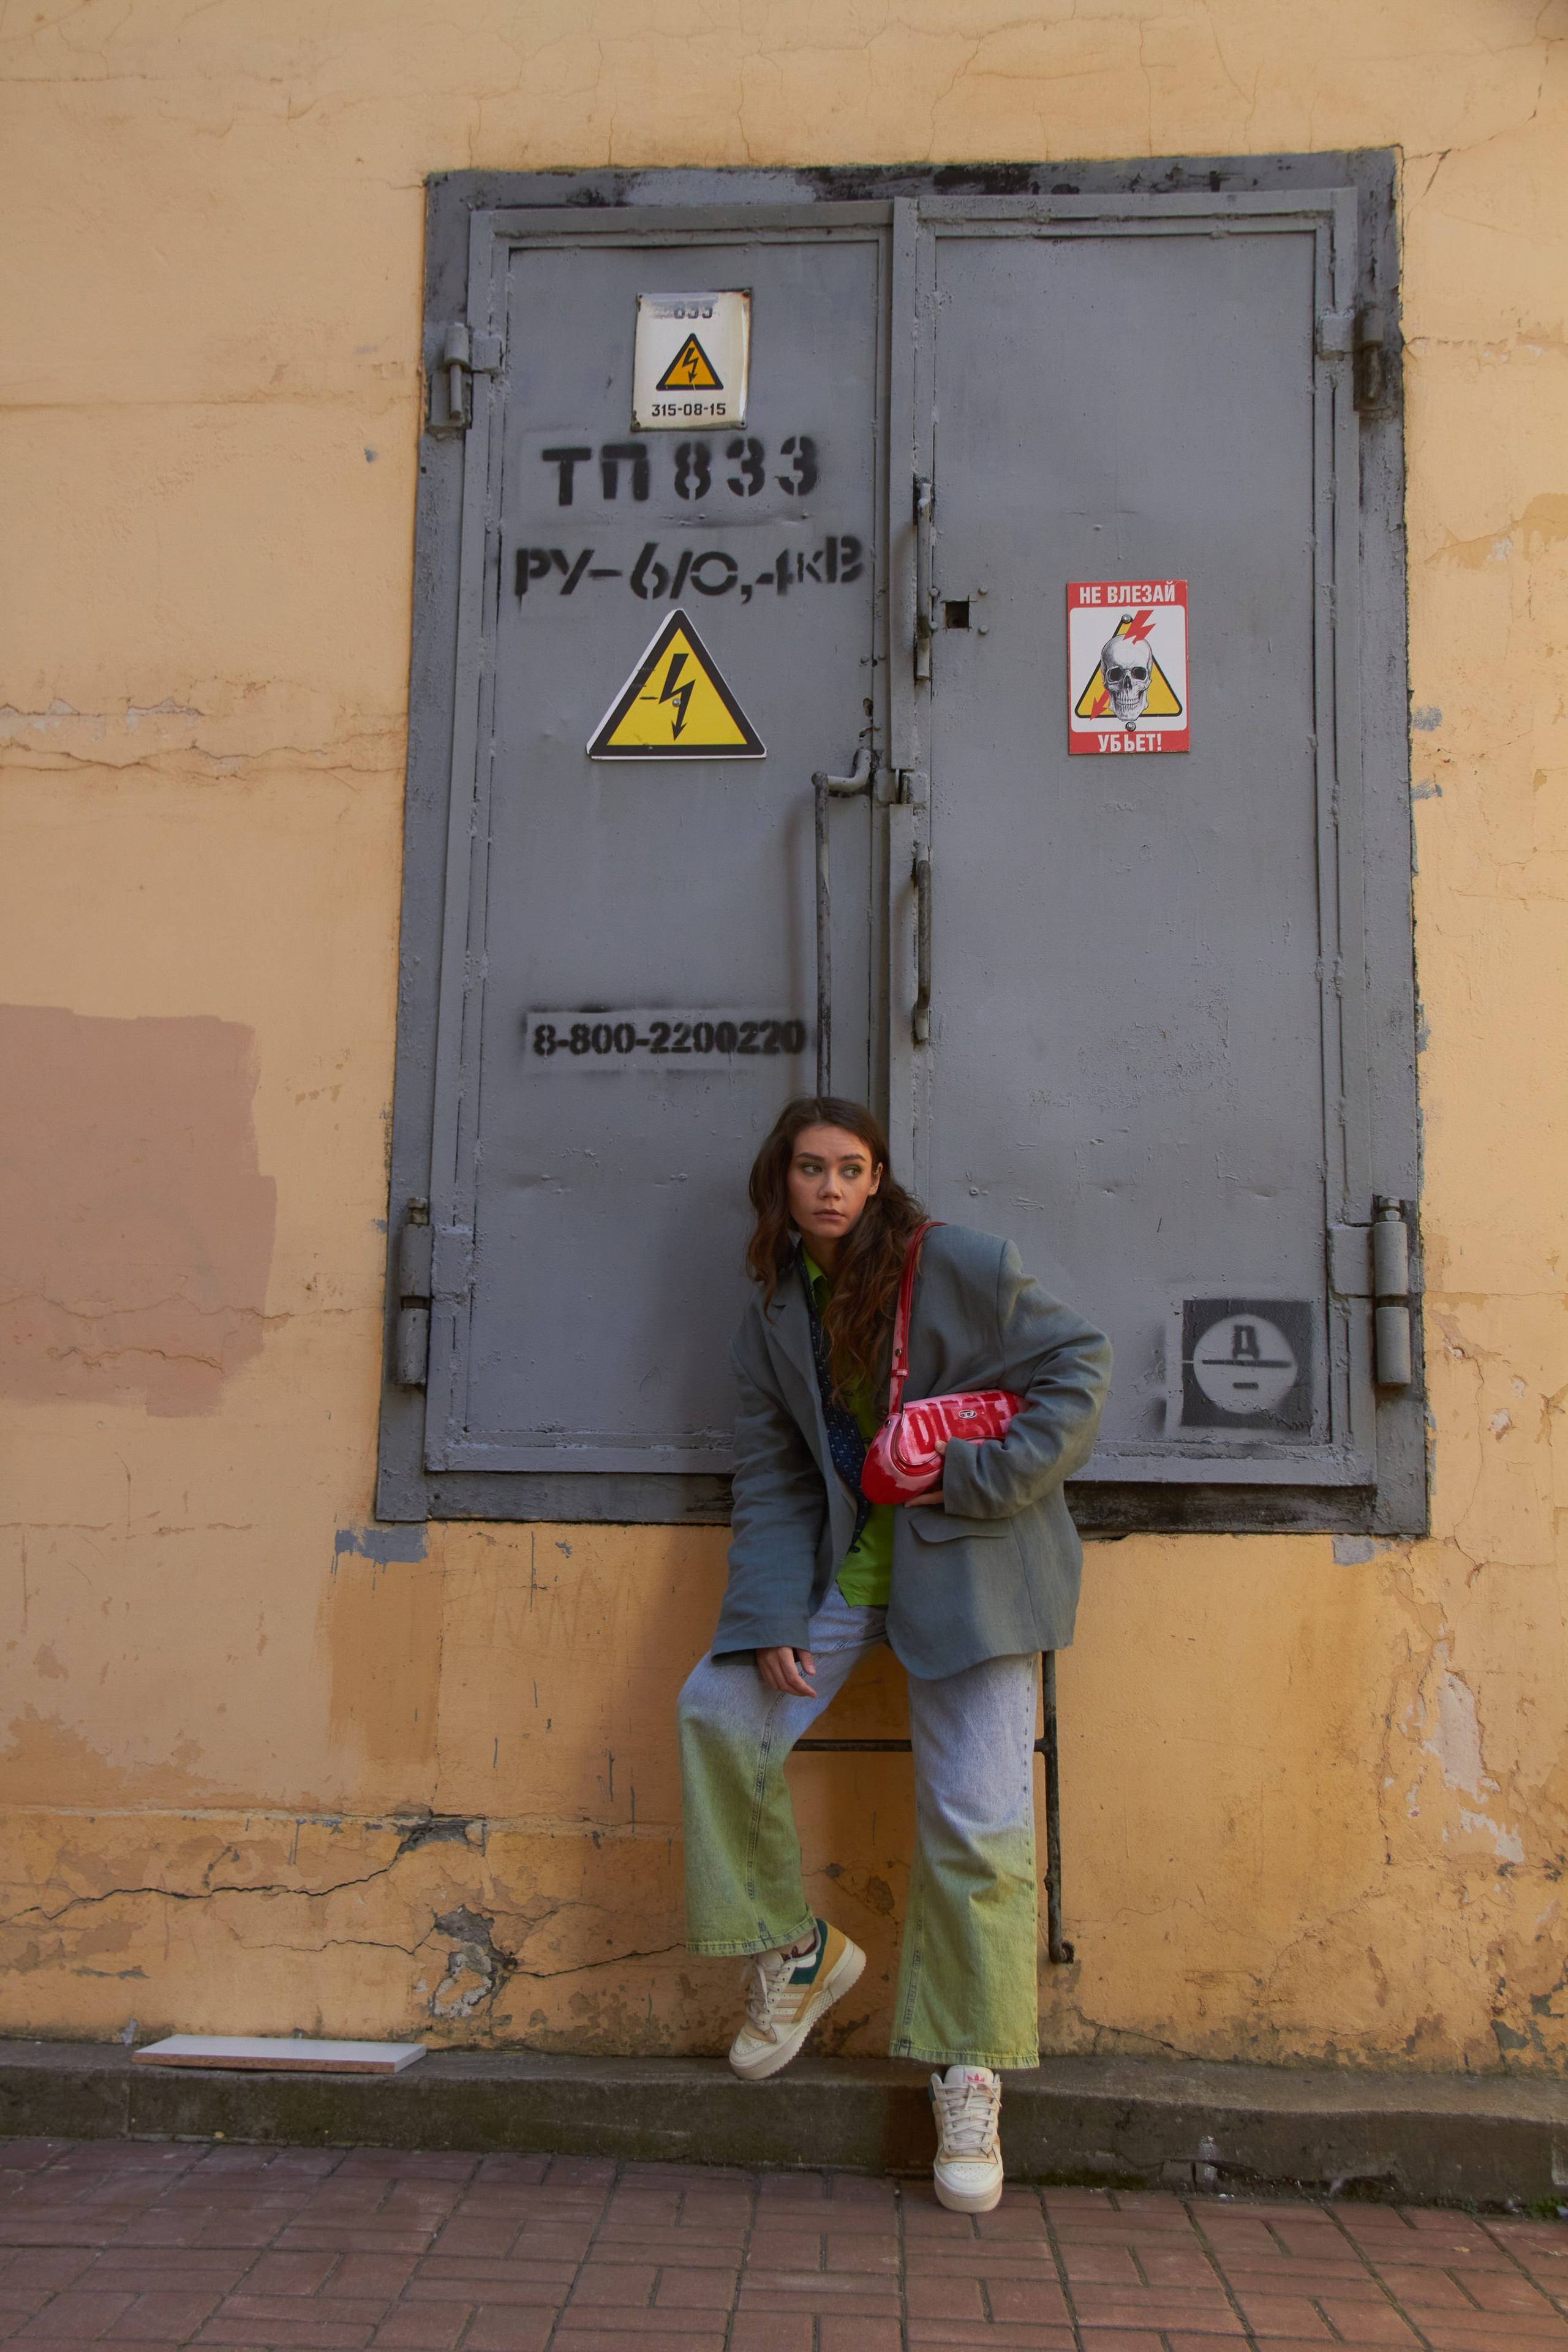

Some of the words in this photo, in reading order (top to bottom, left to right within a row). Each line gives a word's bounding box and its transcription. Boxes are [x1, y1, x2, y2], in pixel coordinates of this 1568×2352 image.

[651, 402, 726, 417] 315-08-15
[542, 442, 650, 507] ТП
[674, 435, 819, 501] 833
[1079, 586, 1102, 605] НЕ
[1107, 581, 1175, 604] ВЛЕЗАЙ
[1097, 733, 1163, 753] УБЬЕТ!
[533, 1019, 807, 1055] 8-800-2200220
